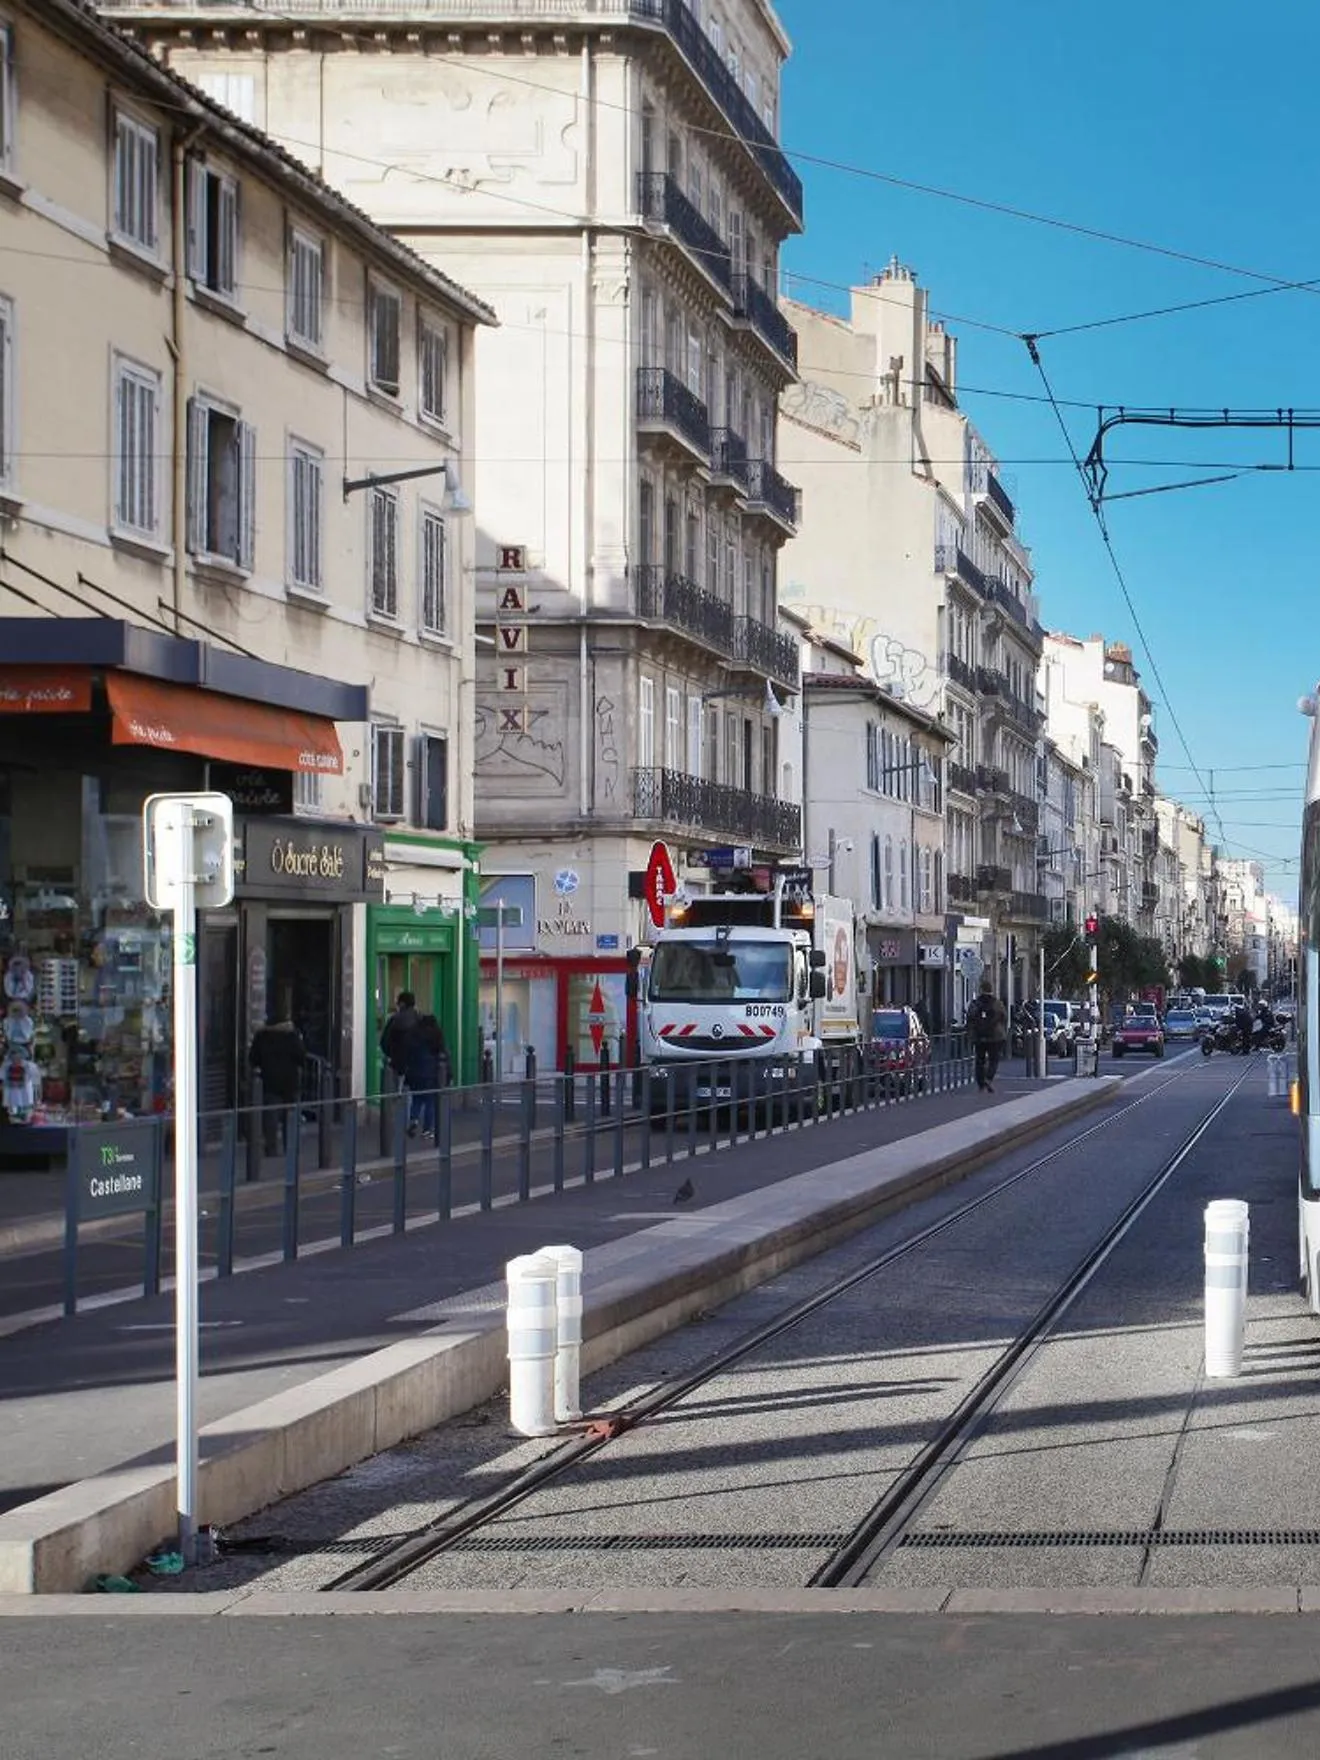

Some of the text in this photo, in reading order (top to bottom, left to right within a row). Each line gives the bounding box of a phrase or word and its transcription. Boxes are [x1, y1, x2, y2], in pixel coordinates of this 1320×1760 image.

[500, 548, 522, 731] RAVIX
[284, 842, 318, 875] Sucré
[319, 845, 344, 878] Salé
[90, 1173, 142, 1197] Castellane
